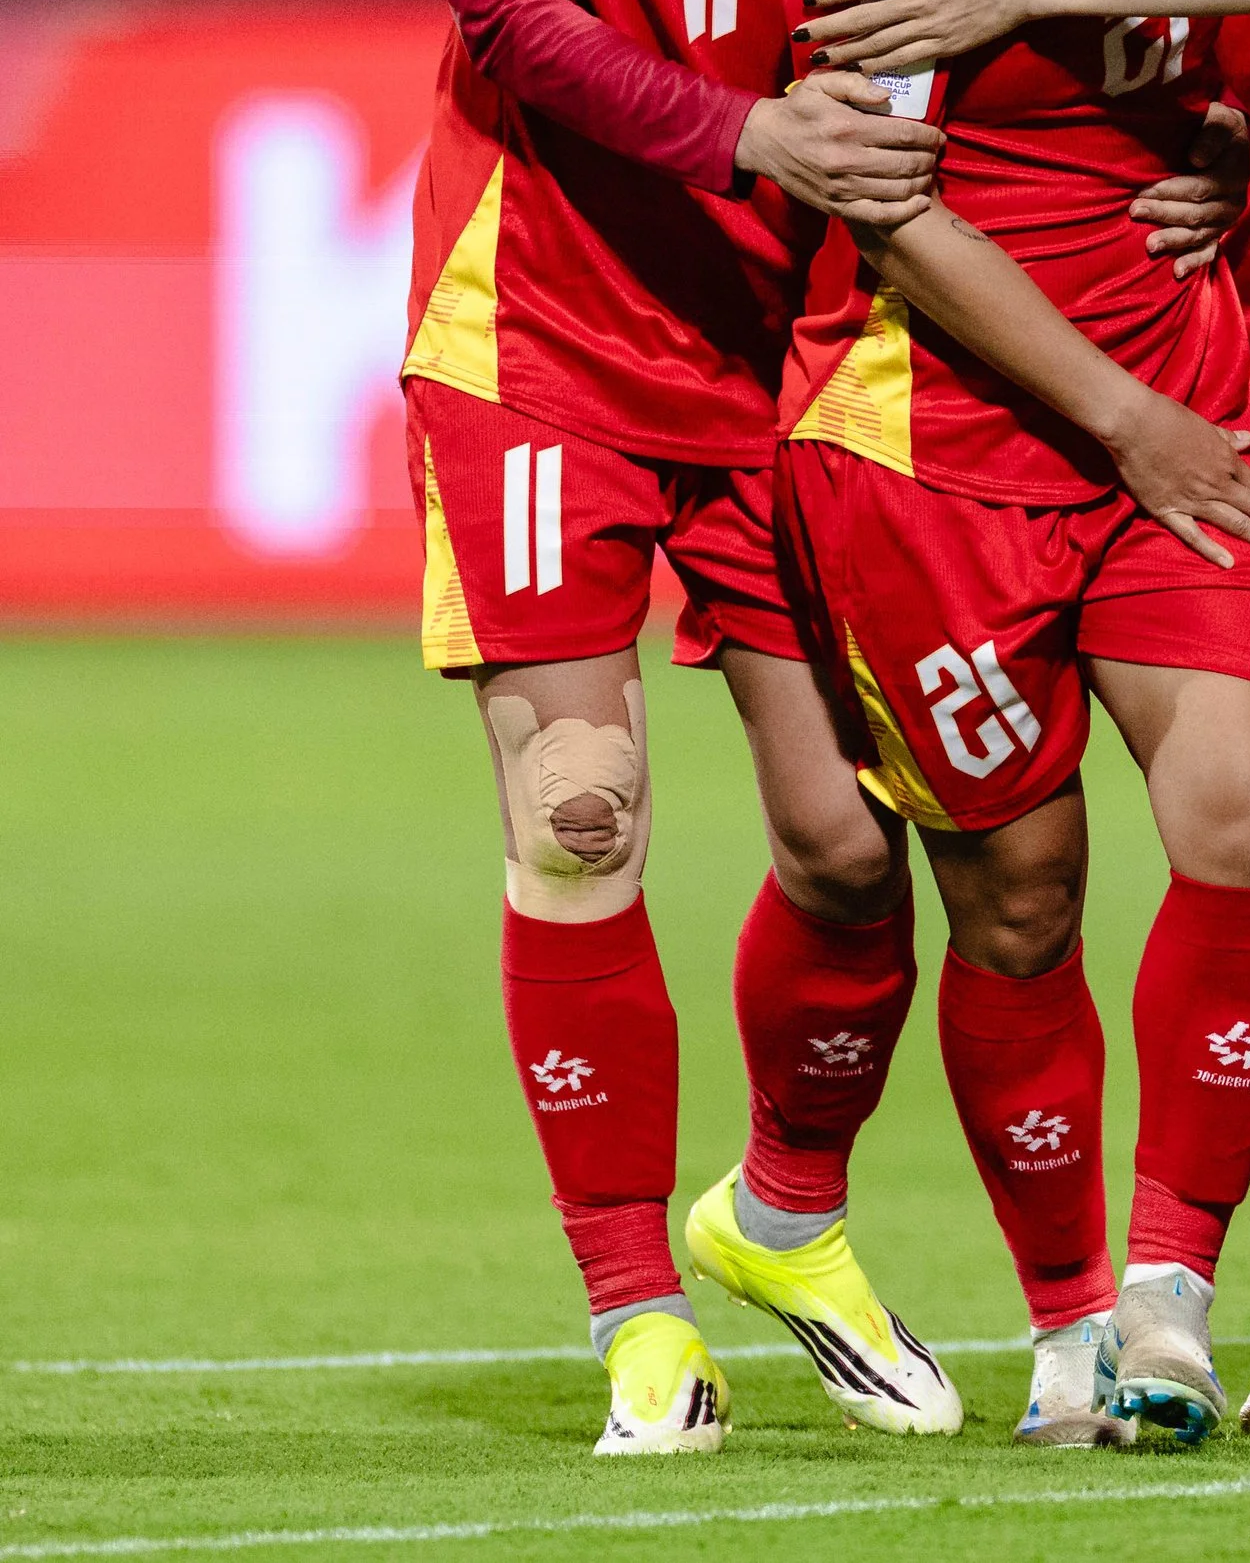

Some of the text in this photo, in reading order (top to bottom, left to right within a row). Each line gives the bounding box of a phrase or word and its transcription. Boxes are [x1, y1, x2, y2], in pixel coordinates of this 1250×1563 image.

[894, 81, 912, 89] CUP
[503, 441, 563, 597] 11
[914, 639, 1042, 780] 21
